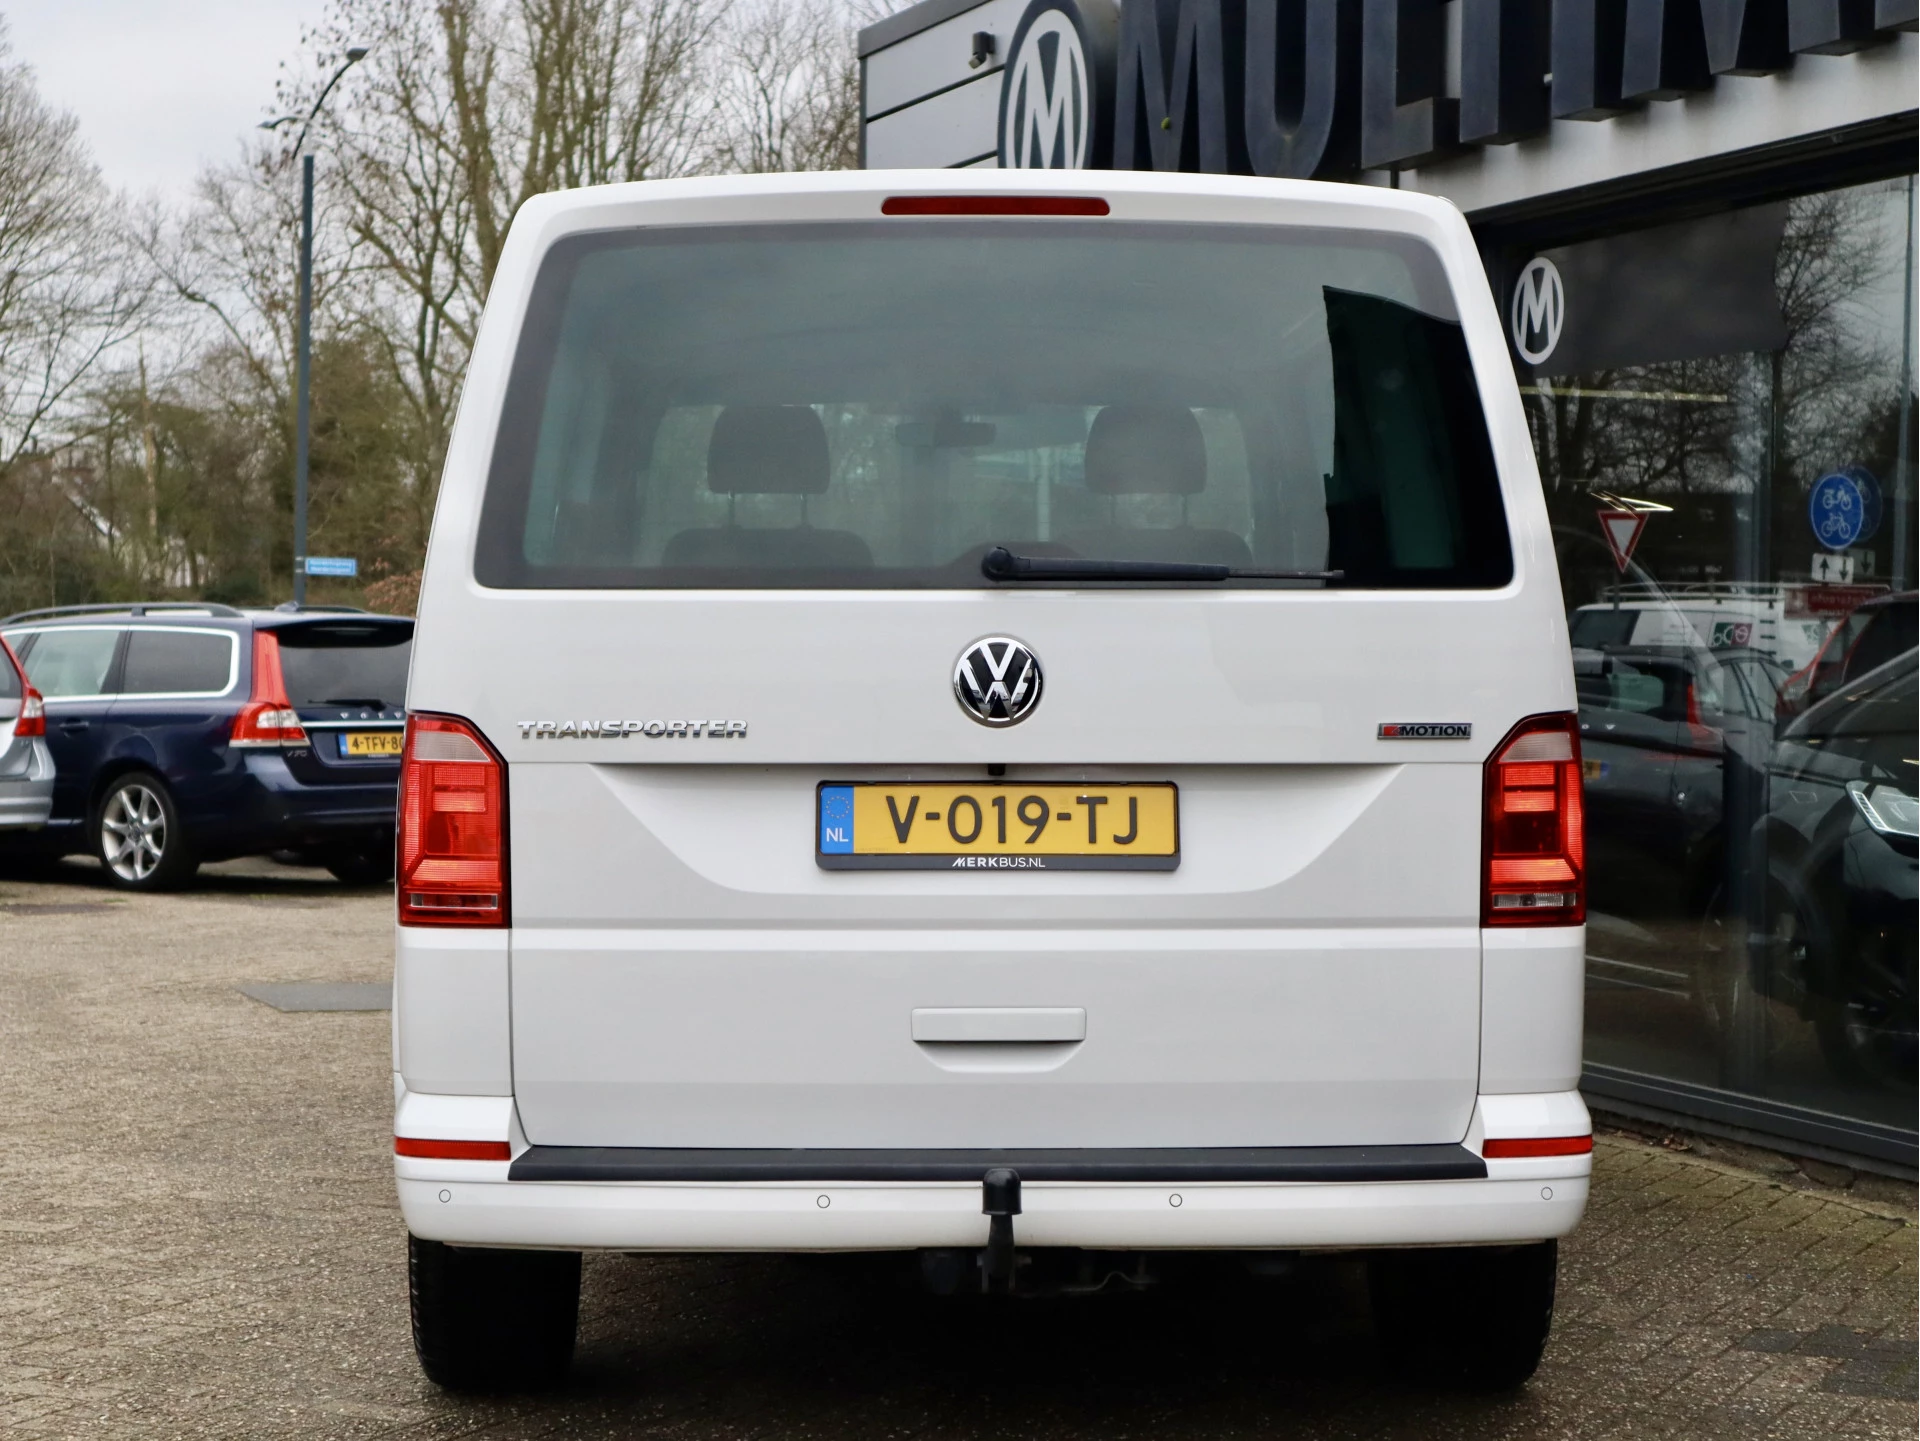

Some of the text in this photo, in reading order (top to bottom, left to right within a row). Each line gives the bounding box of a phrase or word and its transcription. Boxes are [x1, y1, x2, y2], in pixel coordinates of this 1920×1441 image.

[340, 711, 402, 719] VOLV
[517, 720, 748, 739] TRANSPORTER
[885, 794, 1138, 845] V-019-TJ
[826, 827, 849, 842] NL
[952, 857, 1046, 868] MERKBUS.NL
